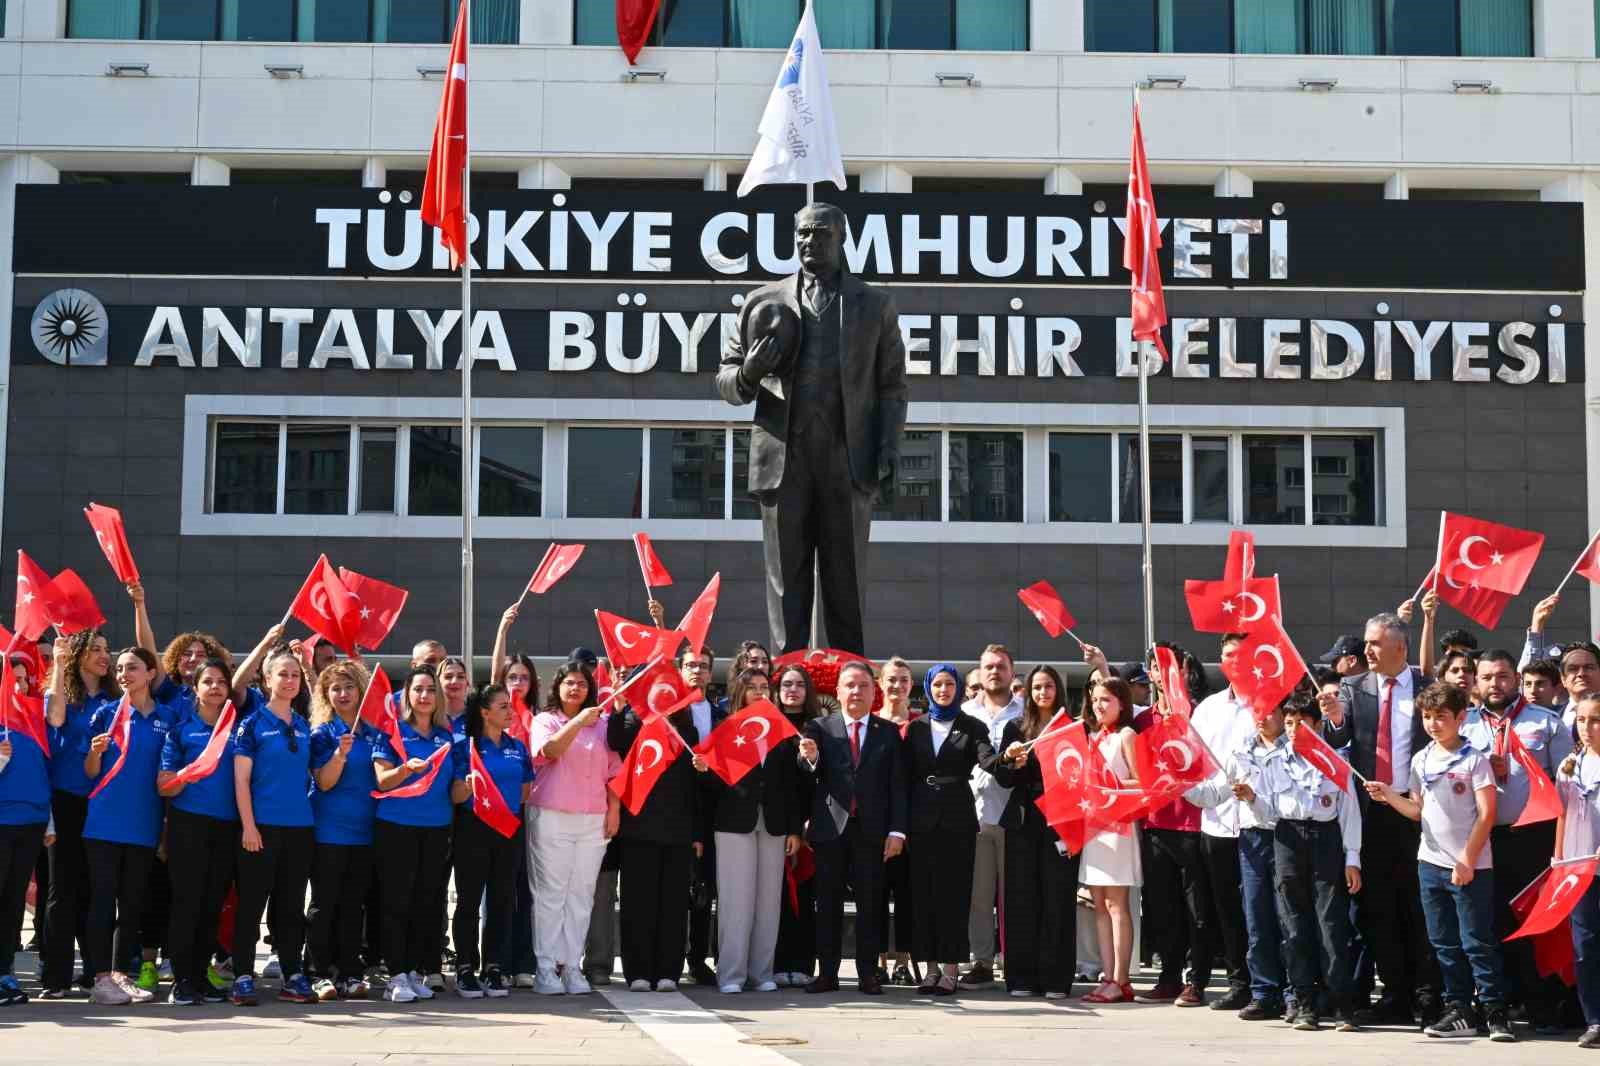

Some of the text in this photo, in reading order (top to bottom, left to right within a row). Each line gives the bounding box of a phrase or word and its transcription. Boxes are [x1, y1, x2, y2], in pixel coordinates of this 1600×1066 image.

[700, 200, 1288, 280] CUMHURİETİ
[134, 292, 1566, 385] ANTALYA BÜYEHİR BELEDİYESİ
